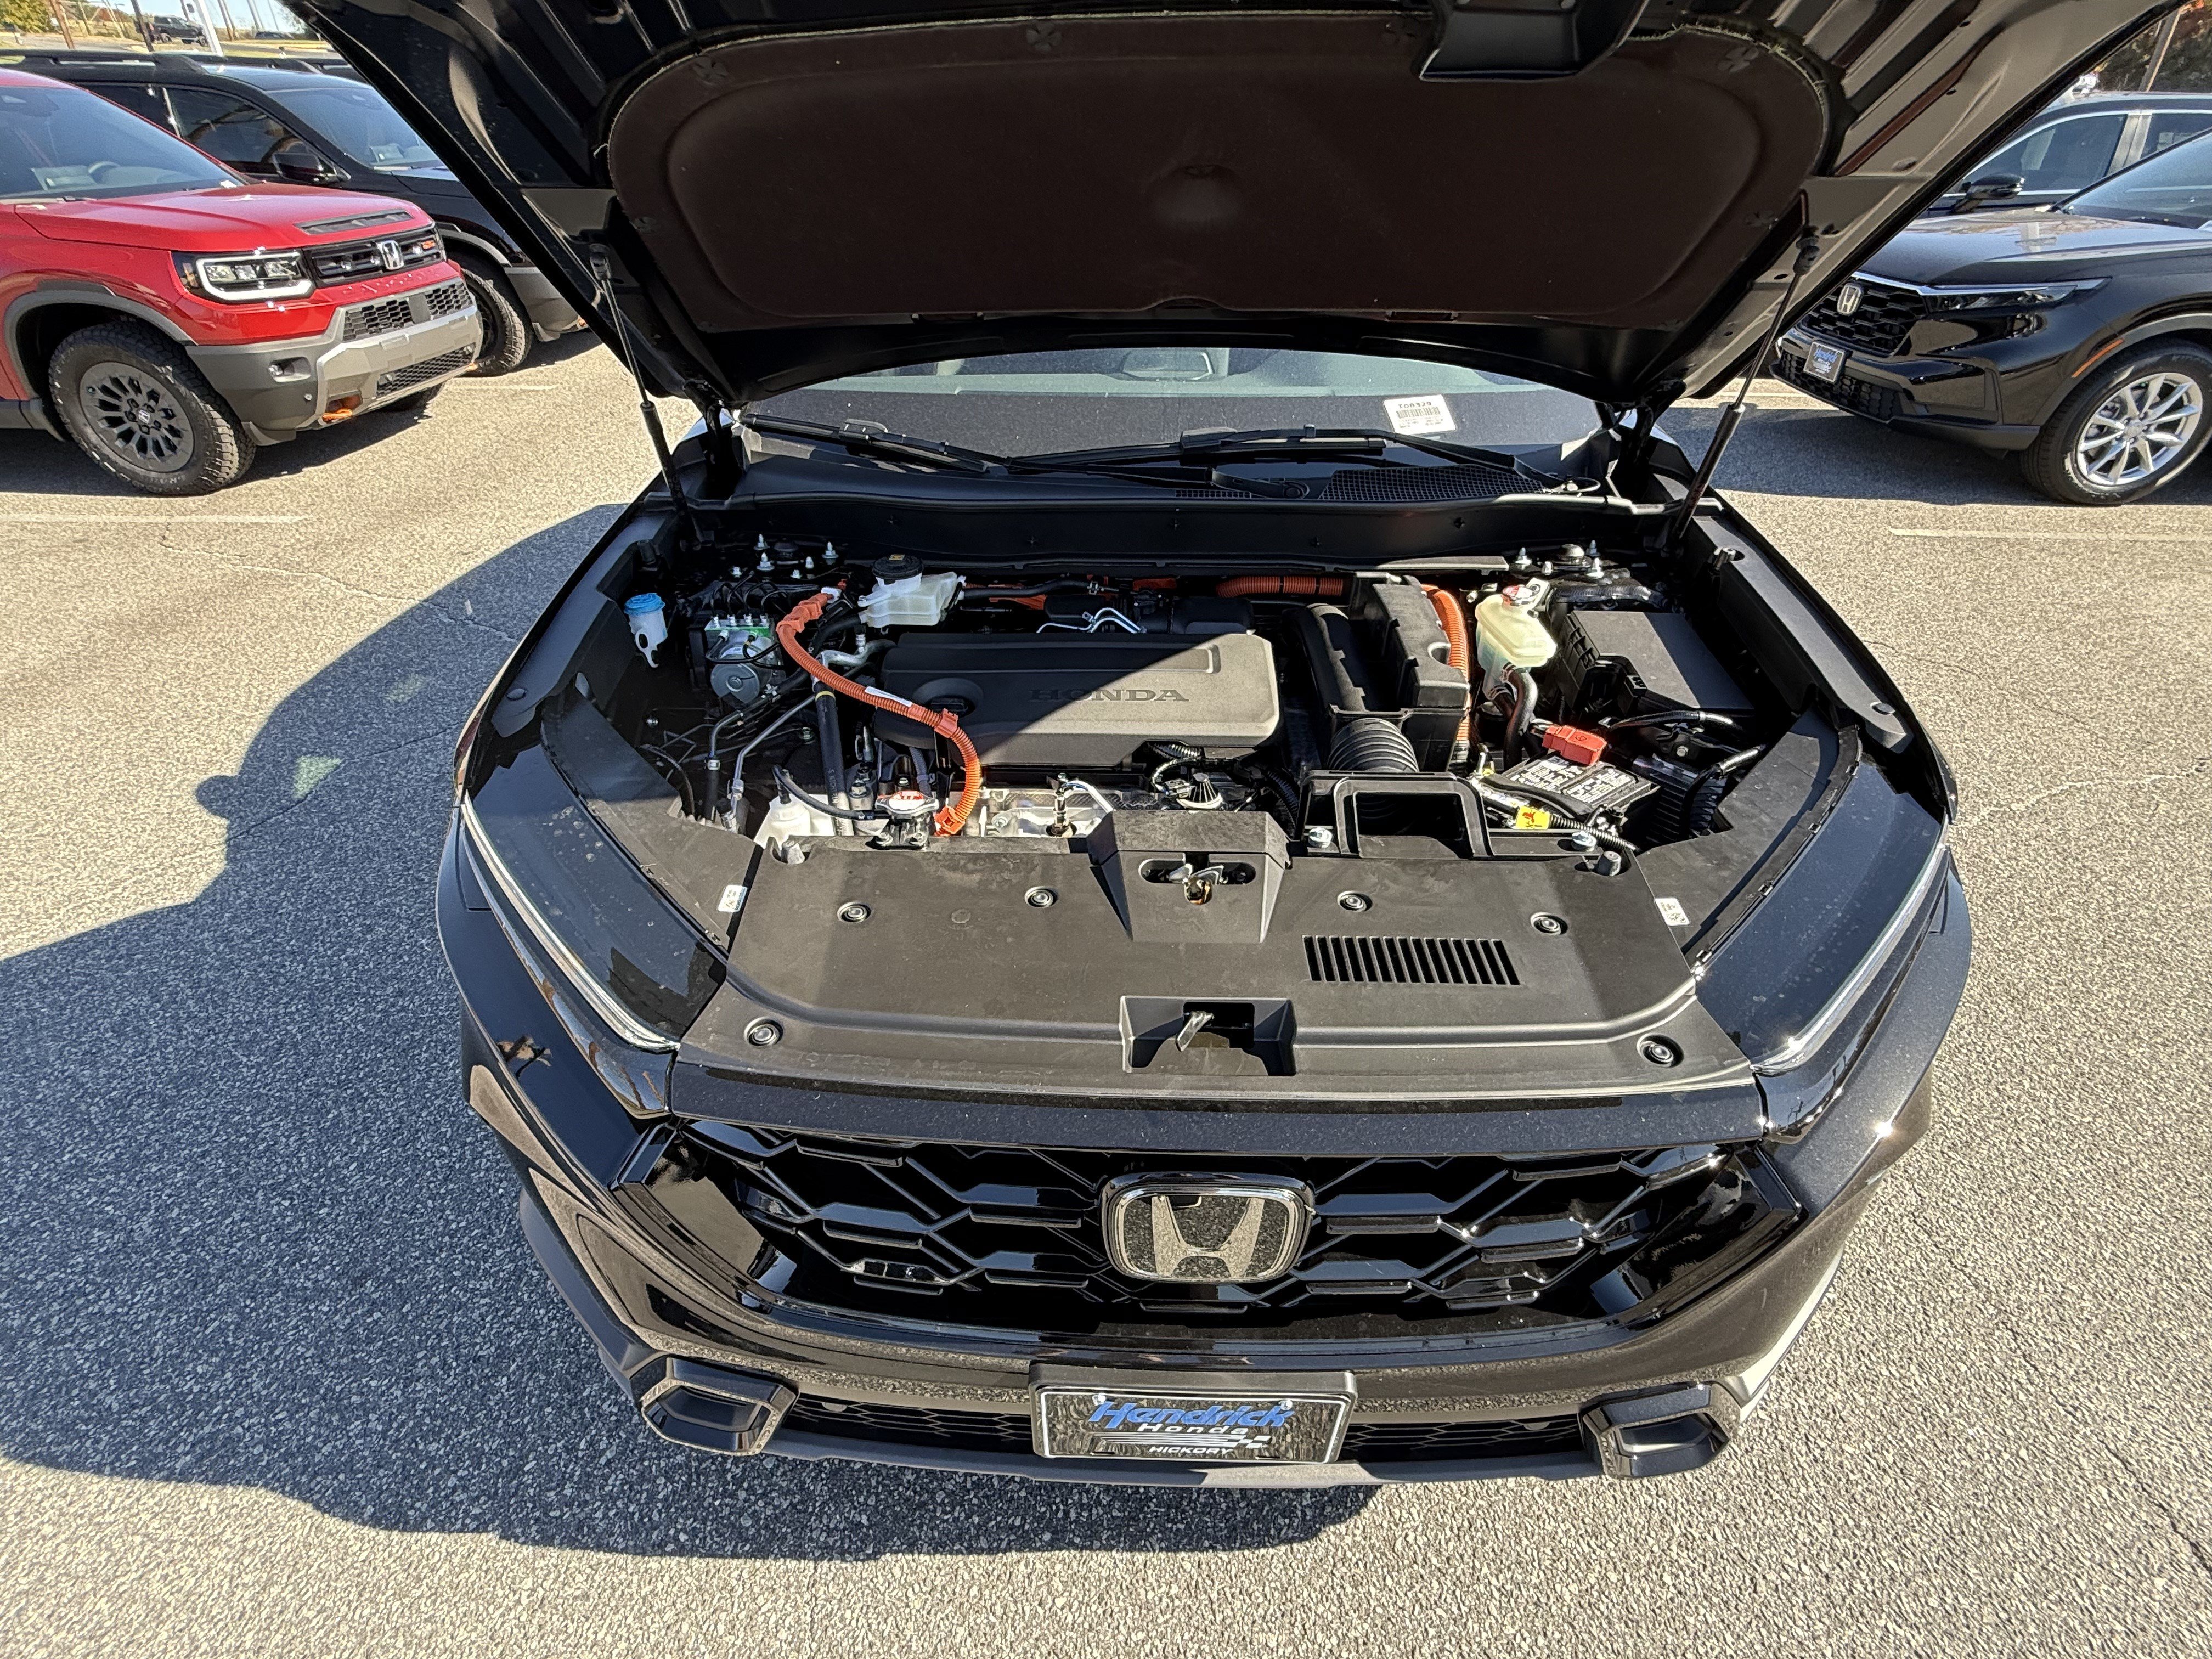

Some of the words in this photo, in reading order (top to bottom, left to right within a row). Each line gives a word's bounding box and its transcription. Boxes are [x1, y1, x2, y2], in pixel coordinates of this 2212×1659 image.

[1028, 688, 1189, 703] HONDA
[1088, 1400, 1295, 1429] Hendrick
[1137, 1423, 1249, 1435] Honda
[1148, 1446, 1234, 1455] HICKORY
